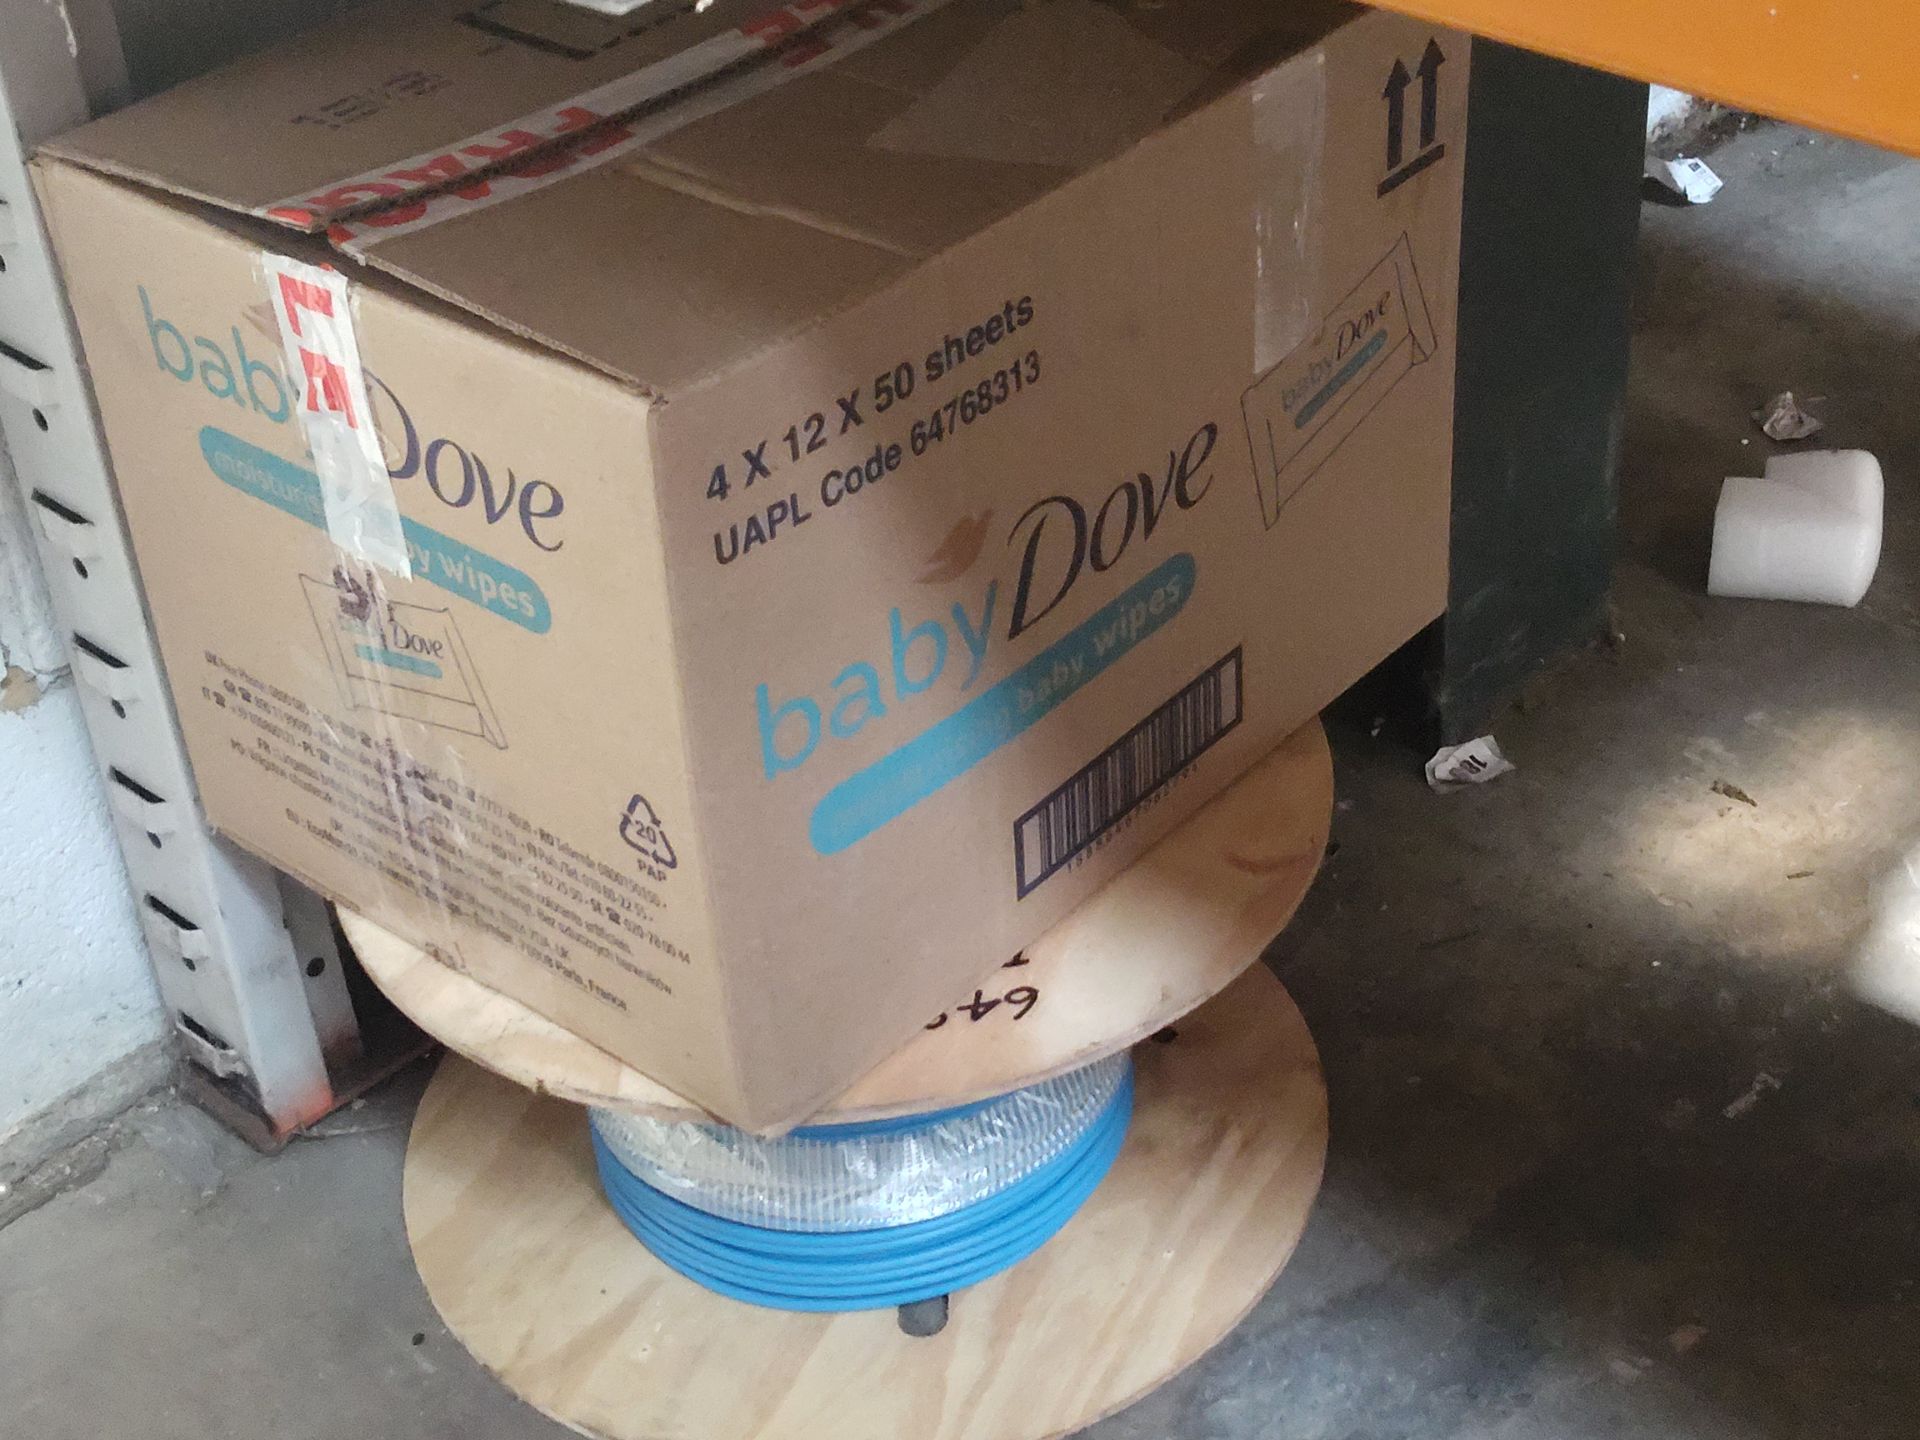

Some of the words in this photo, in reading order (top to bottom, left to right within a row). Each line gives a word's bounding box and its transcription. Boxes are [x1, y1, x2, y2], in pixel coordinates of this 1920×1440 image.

[1336, 290, 1391, 361] Dove
[706, 464, 731, 501] 4
[742, 440, 771, 489] X
[782, 412, 827, 462] 12
[835, 387, 864, 435] X
[873, 361, 915, 413] 50
[924, 295, 1035, 382] sheets
[713, 493, 813, 565] UAPL
[819, 443, 903, 508] Code
[910, 349, 1041, 456] 64768313
[434, 546, 536, 619] wipes
[754, 579, 999, 782] baby
[1007, 421, 1219, 642] Dove
[1092, 573, 1182, 655] wipes
[392, 621, 445, 660] Dove
[635, 820, 658, 845] 20
[637, 857, 668, 882] PAP
